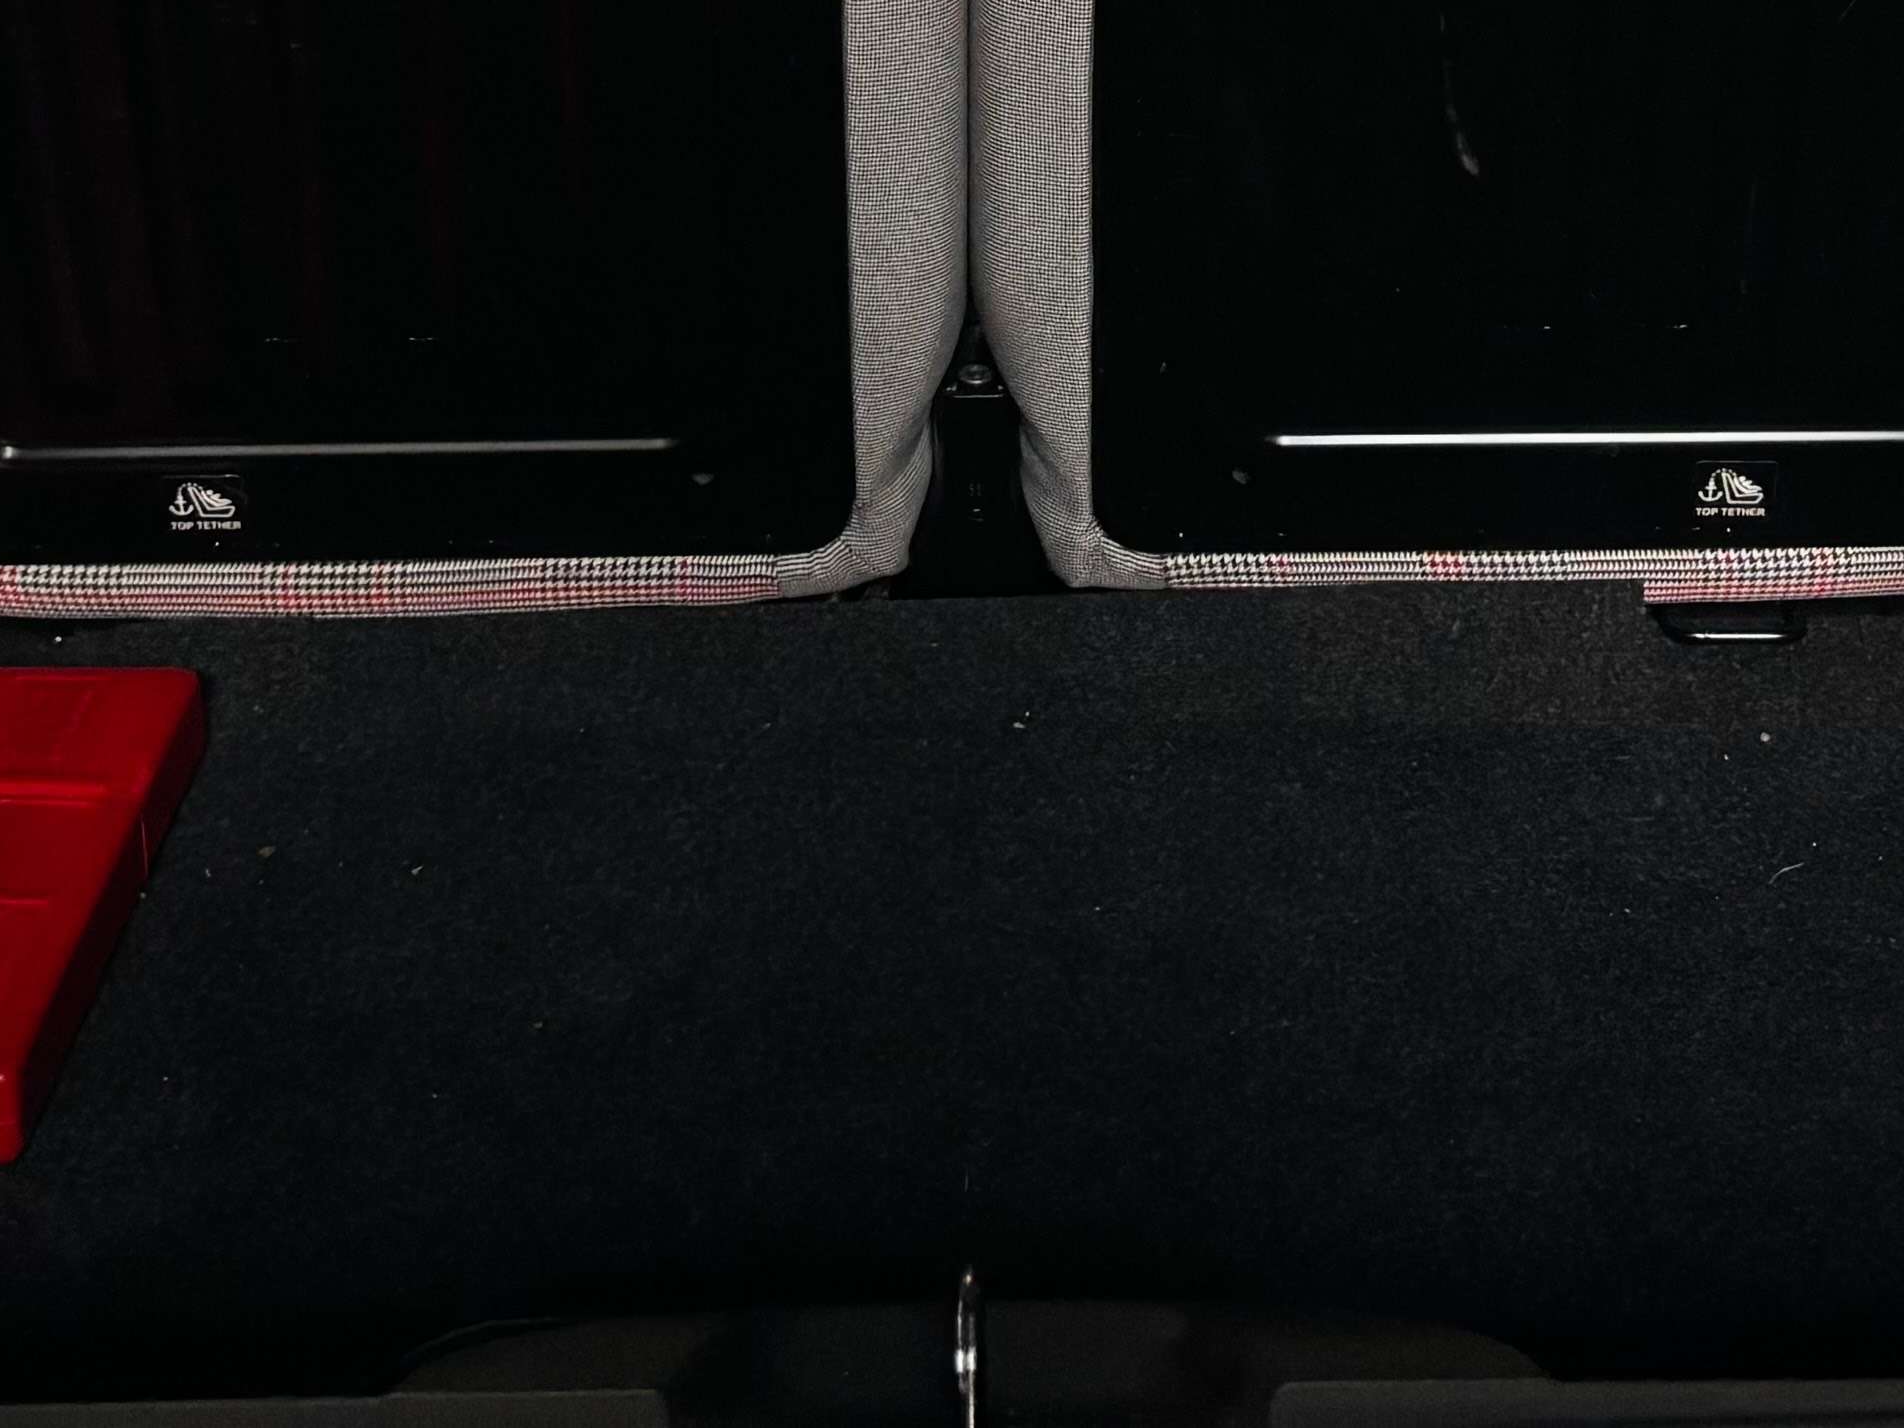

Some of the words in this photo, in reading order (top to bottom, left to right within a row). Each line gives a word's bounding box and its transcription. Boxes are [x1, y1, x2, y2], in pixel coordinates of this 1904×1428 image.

[1696, 507, 1719, 517] TOP
[1721, 507, 1766, 517] TETHER
[169, 520, 195, 531] TOP
[196, 520, 242, 531] TETHER
